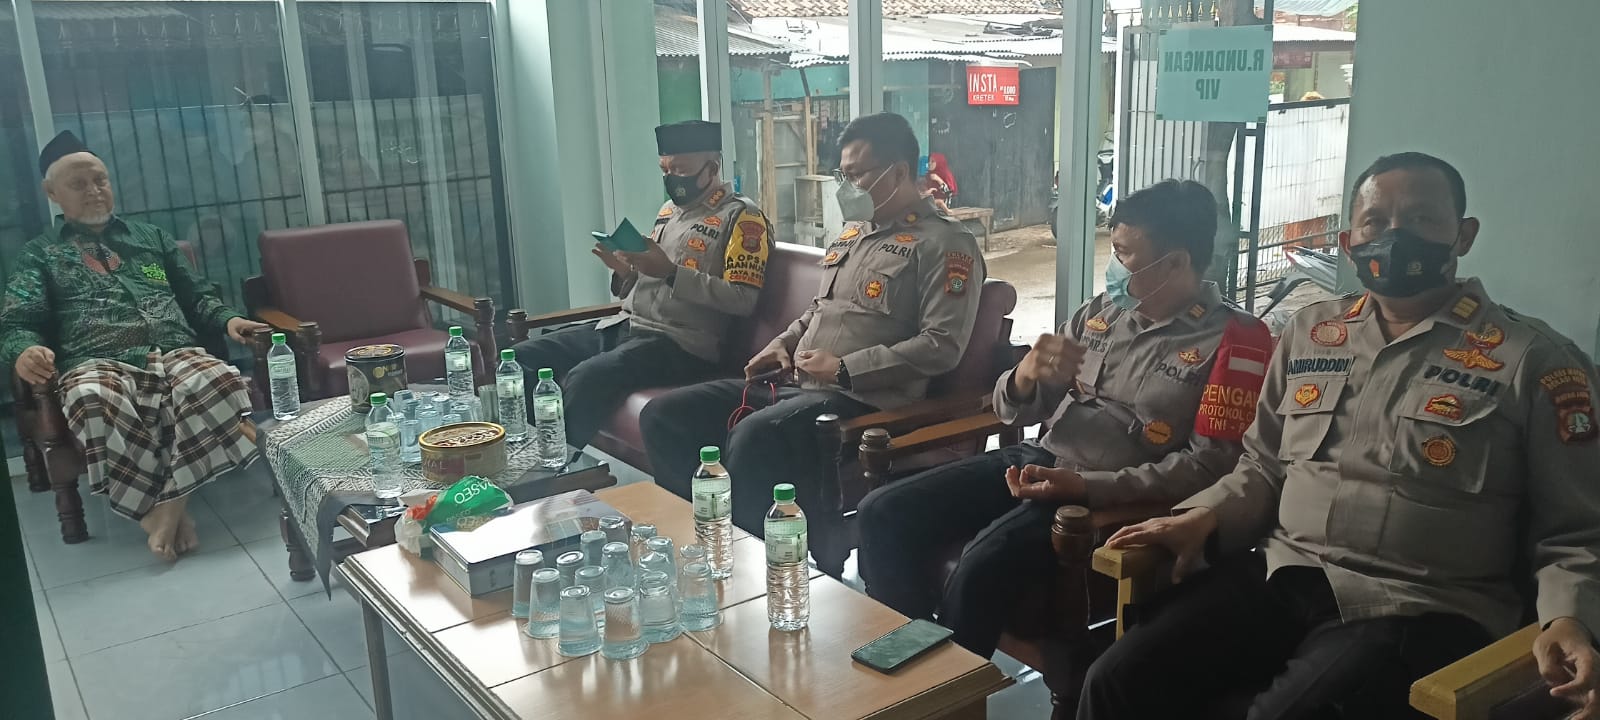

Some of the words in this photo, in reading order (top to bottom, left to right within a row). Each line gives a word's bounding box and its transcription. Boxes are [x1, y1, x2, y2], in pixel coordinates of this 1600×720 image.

[969, 72, 998, 93] INSTA
[690, 223, 721, 240] POLRI
[737, 254, 760, 264] OPS
[879, 243, 912, 259] POLRI
[1288, 357, 1350, 376] AMIRUDDIN
[1423, 365, 1501, 396] POLRI
[1201, 384, 1258, 409] PENGA
[1198, 403, 1245, 421] PROTOKOL
[1208, 417, 1227, 431] TNI
